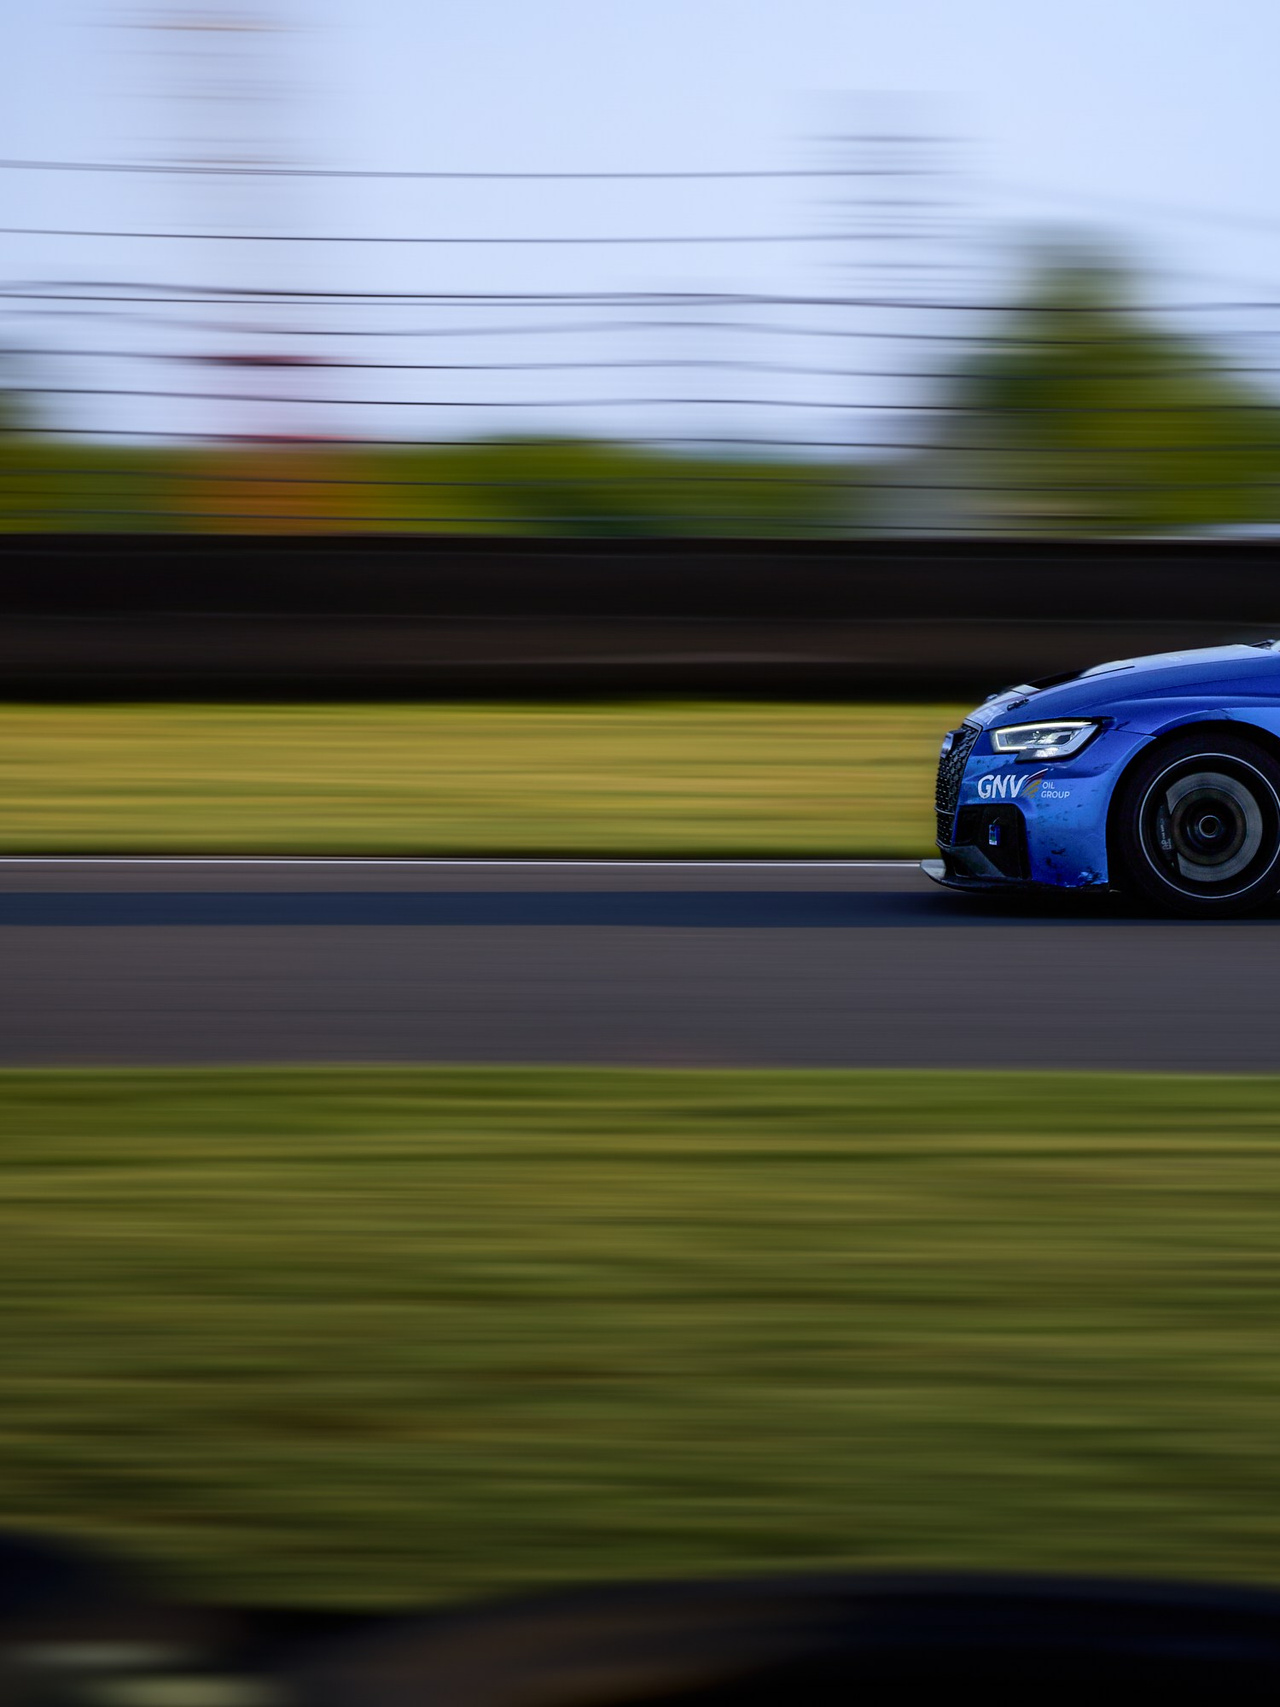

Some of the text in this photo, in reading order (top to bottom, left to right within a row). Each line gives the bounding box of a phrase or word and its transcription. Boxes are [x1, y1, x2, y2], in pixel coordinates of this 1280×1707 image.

[977, 774, 1029, 799] GNV
[1042, 781, 1055, 789] OIL
[1041, 790, 1070, 799] GROUP
